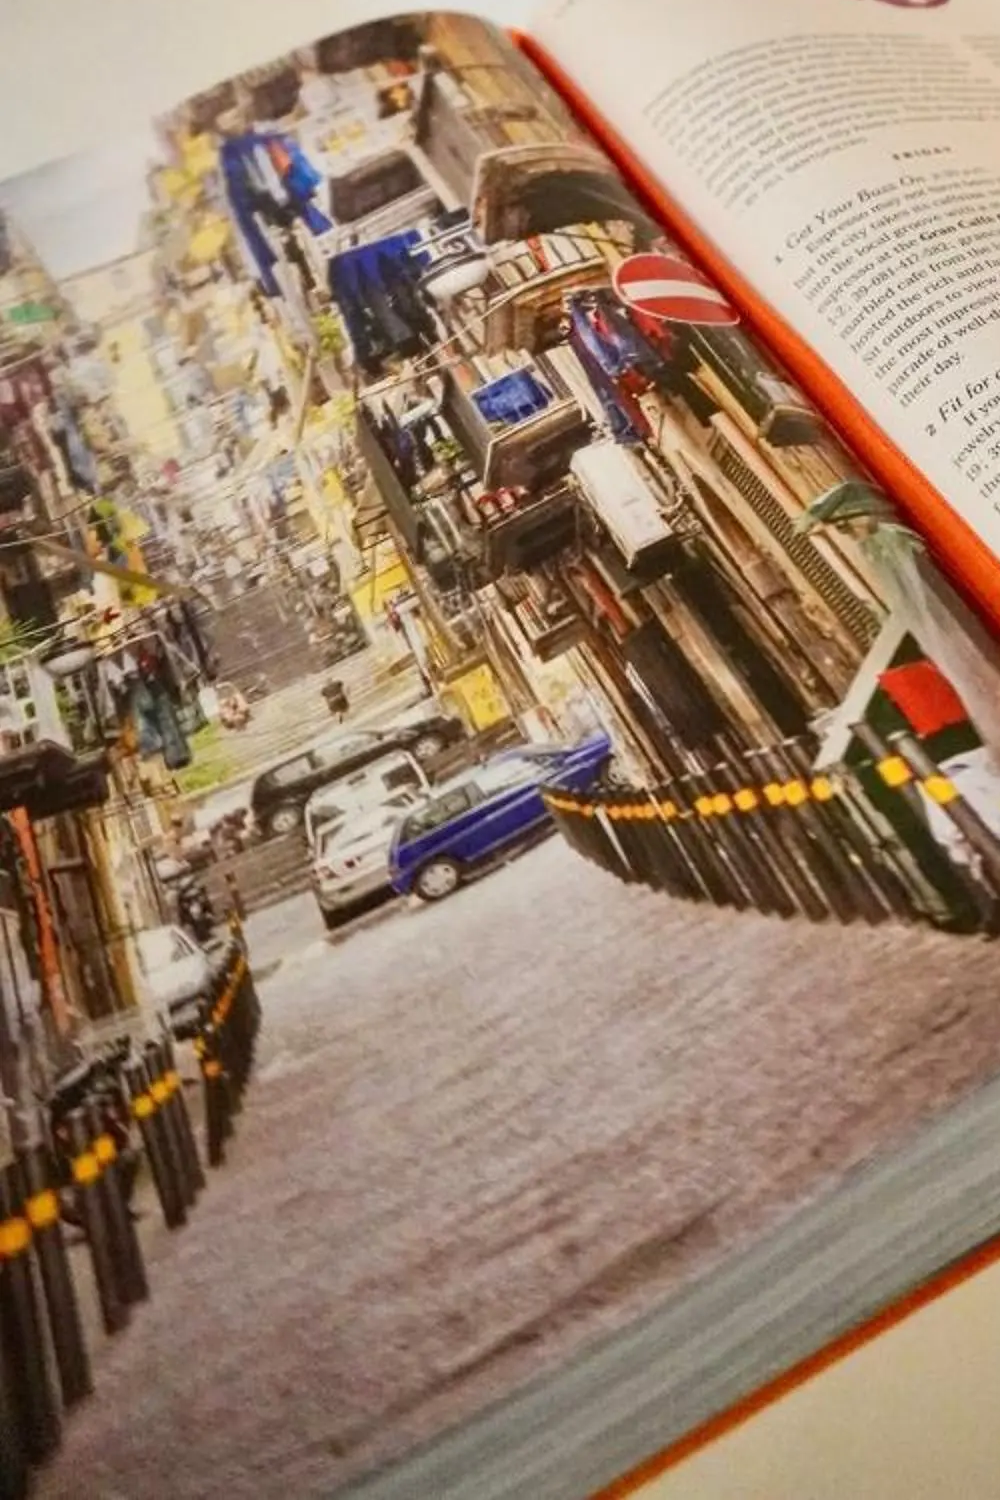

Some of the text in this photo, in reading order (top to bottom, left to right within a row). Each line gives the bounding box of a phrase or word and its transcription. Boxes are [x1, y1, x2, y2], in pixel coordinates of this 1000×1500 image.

[785, 224, 814, 250] Get
[814, 201, 853, 226] Your
[841, 229, 868, 247] city
[855, 234, 892, 257] local
[817, 261, 875, 314] espresso
[877, 250, 893, 263] at
[892, 239, 918, 256] the
[919, 223, 957, 242] Gran
[839, 287, 896, 340] marbled
[930, 252, 967, 274] from
[966, 242, 991, 258] the
[850, 264, 984, 354] hosted the rich and
[862, 345, 882, 366] Sit
[882, 298, 945, 348] outdoors
[946, 288, 963, 302] to
[964, 275, 998, 294] view
[874, 353, 898, 381] the
[898, 327, 934, 357] most
[886, 343, 937, 396] parade
[937, 332, 954, 349] of
[900, 348, 966, 408] their day.
[925, 423, 938, 437] 2
[937, 396, 969, 423] Fit
[965, 376, 991, 400] for
[962, 409, 978, 427] If
